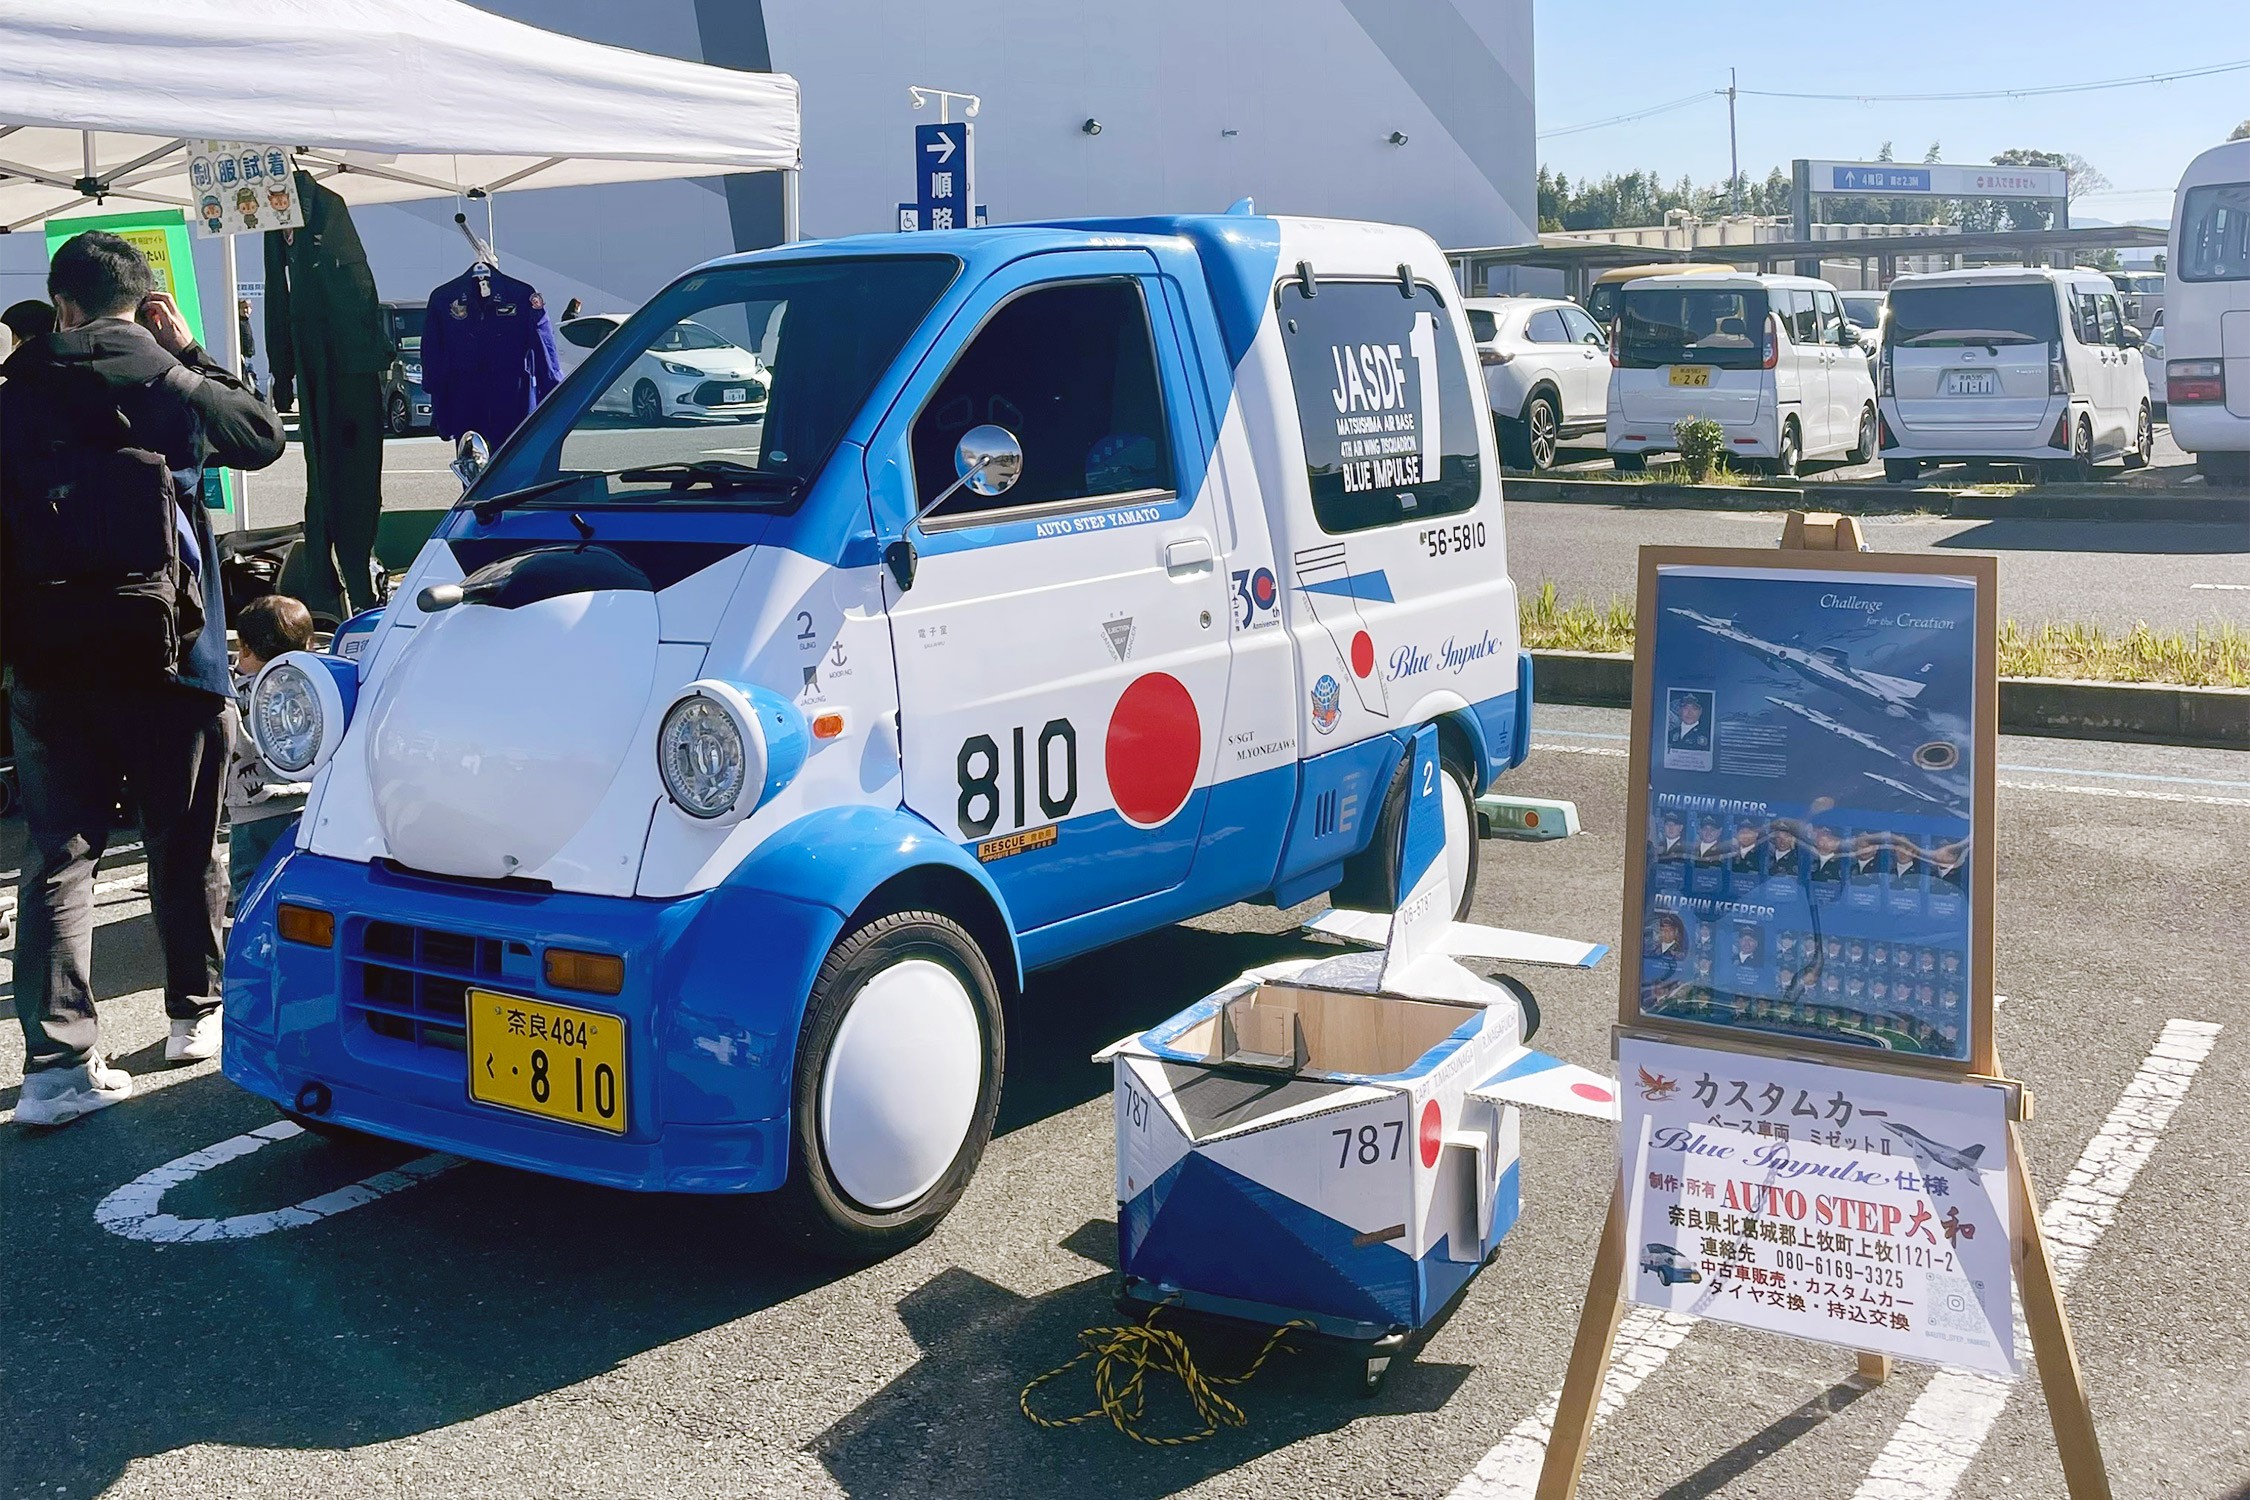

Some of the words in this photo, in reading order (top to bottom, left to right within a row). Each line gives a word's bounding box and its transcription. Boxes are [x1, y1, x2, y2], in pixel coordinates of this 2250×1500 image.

[193, 152, 285, 186] 制服試着
[931, 172, 953, 230] 順路
[1331, 343, 1406, 414] JASDF
[1960, 381, 1989, 394] 11-11
[1409, 311, 1441, 483] 1
[1336, 416, 1383, 436] MATSUSHIMA
[1384, 414, 1396, 432] AIR
[1395, 413, 1415, 431] BASE
[1341, 441, 1353, 458] 4TH
[1353, 440, 1364, 457] AIR
[1364, 438, 1380, 456] WING
[1342, 461, 1373, 493] BLUE
[1373, 456, 1420, 489] IMPULSE
[1036, 520, 1072, 537] AUTO
[1073, 515, 1106, 532] STEP
[1107, 507, 1160, 527] YAMATO
[1820, 593, 1883, 615] Challenge
[1865, 616, 1880, 627] for
[1880, 617, 1894, 626] the
[1896, 612, 1955, 630] Creation
[800, 641, 817, 651] SLING
[1387, 645, 1433, 682] Blue
[1437, 630, 1502, 675] Impulse
[800, 695, 827, 707] JACKING
[1228, 731, 1255, 745] S/SGT
[1237, 739, 1296, 761] M.YONEZAWA
[957, 717, 1077, 839] 810
[1423, 761, 1433, 797] 2
[1659, 792, 1716, 812] DOLPHIN
[1719, 799, 1768, 818] RIDERS
[983, 836, 1025, 855] RESCUE
[1655, 893, 1712, 914] DOLPHIN
[1714, 900, 1775, 919] KEEPERS
[507, 1008, 588, 1050] 奈良484
[1124, 1081, 1149, 1133] 787
[1691, 1072, 1889, 1129] カスタムカー
[1332, 1121, 1404, 1169] 787
[1707, 1114, 1790, 1143] ベース車両
[1649, 1127, 1735, 1160] Blue
[1743, 1144, 1890, 1186] Impulse
[1894, 1170, 1950, 1196] 仕様
[1720, 1179, 1808, 1221] AUTO
[1815, 1194, 1901, 1237] STEP
[1905, 1200, 1976, 1250] 大和
[1668, 1204, 1954, 1273] 奈良県北葛城郡上牧町上牧1121-2
[1700, 1236, 1756, 1264] 連絡先
[1776, 1252, 1904, 1290] 080-6169-3325
